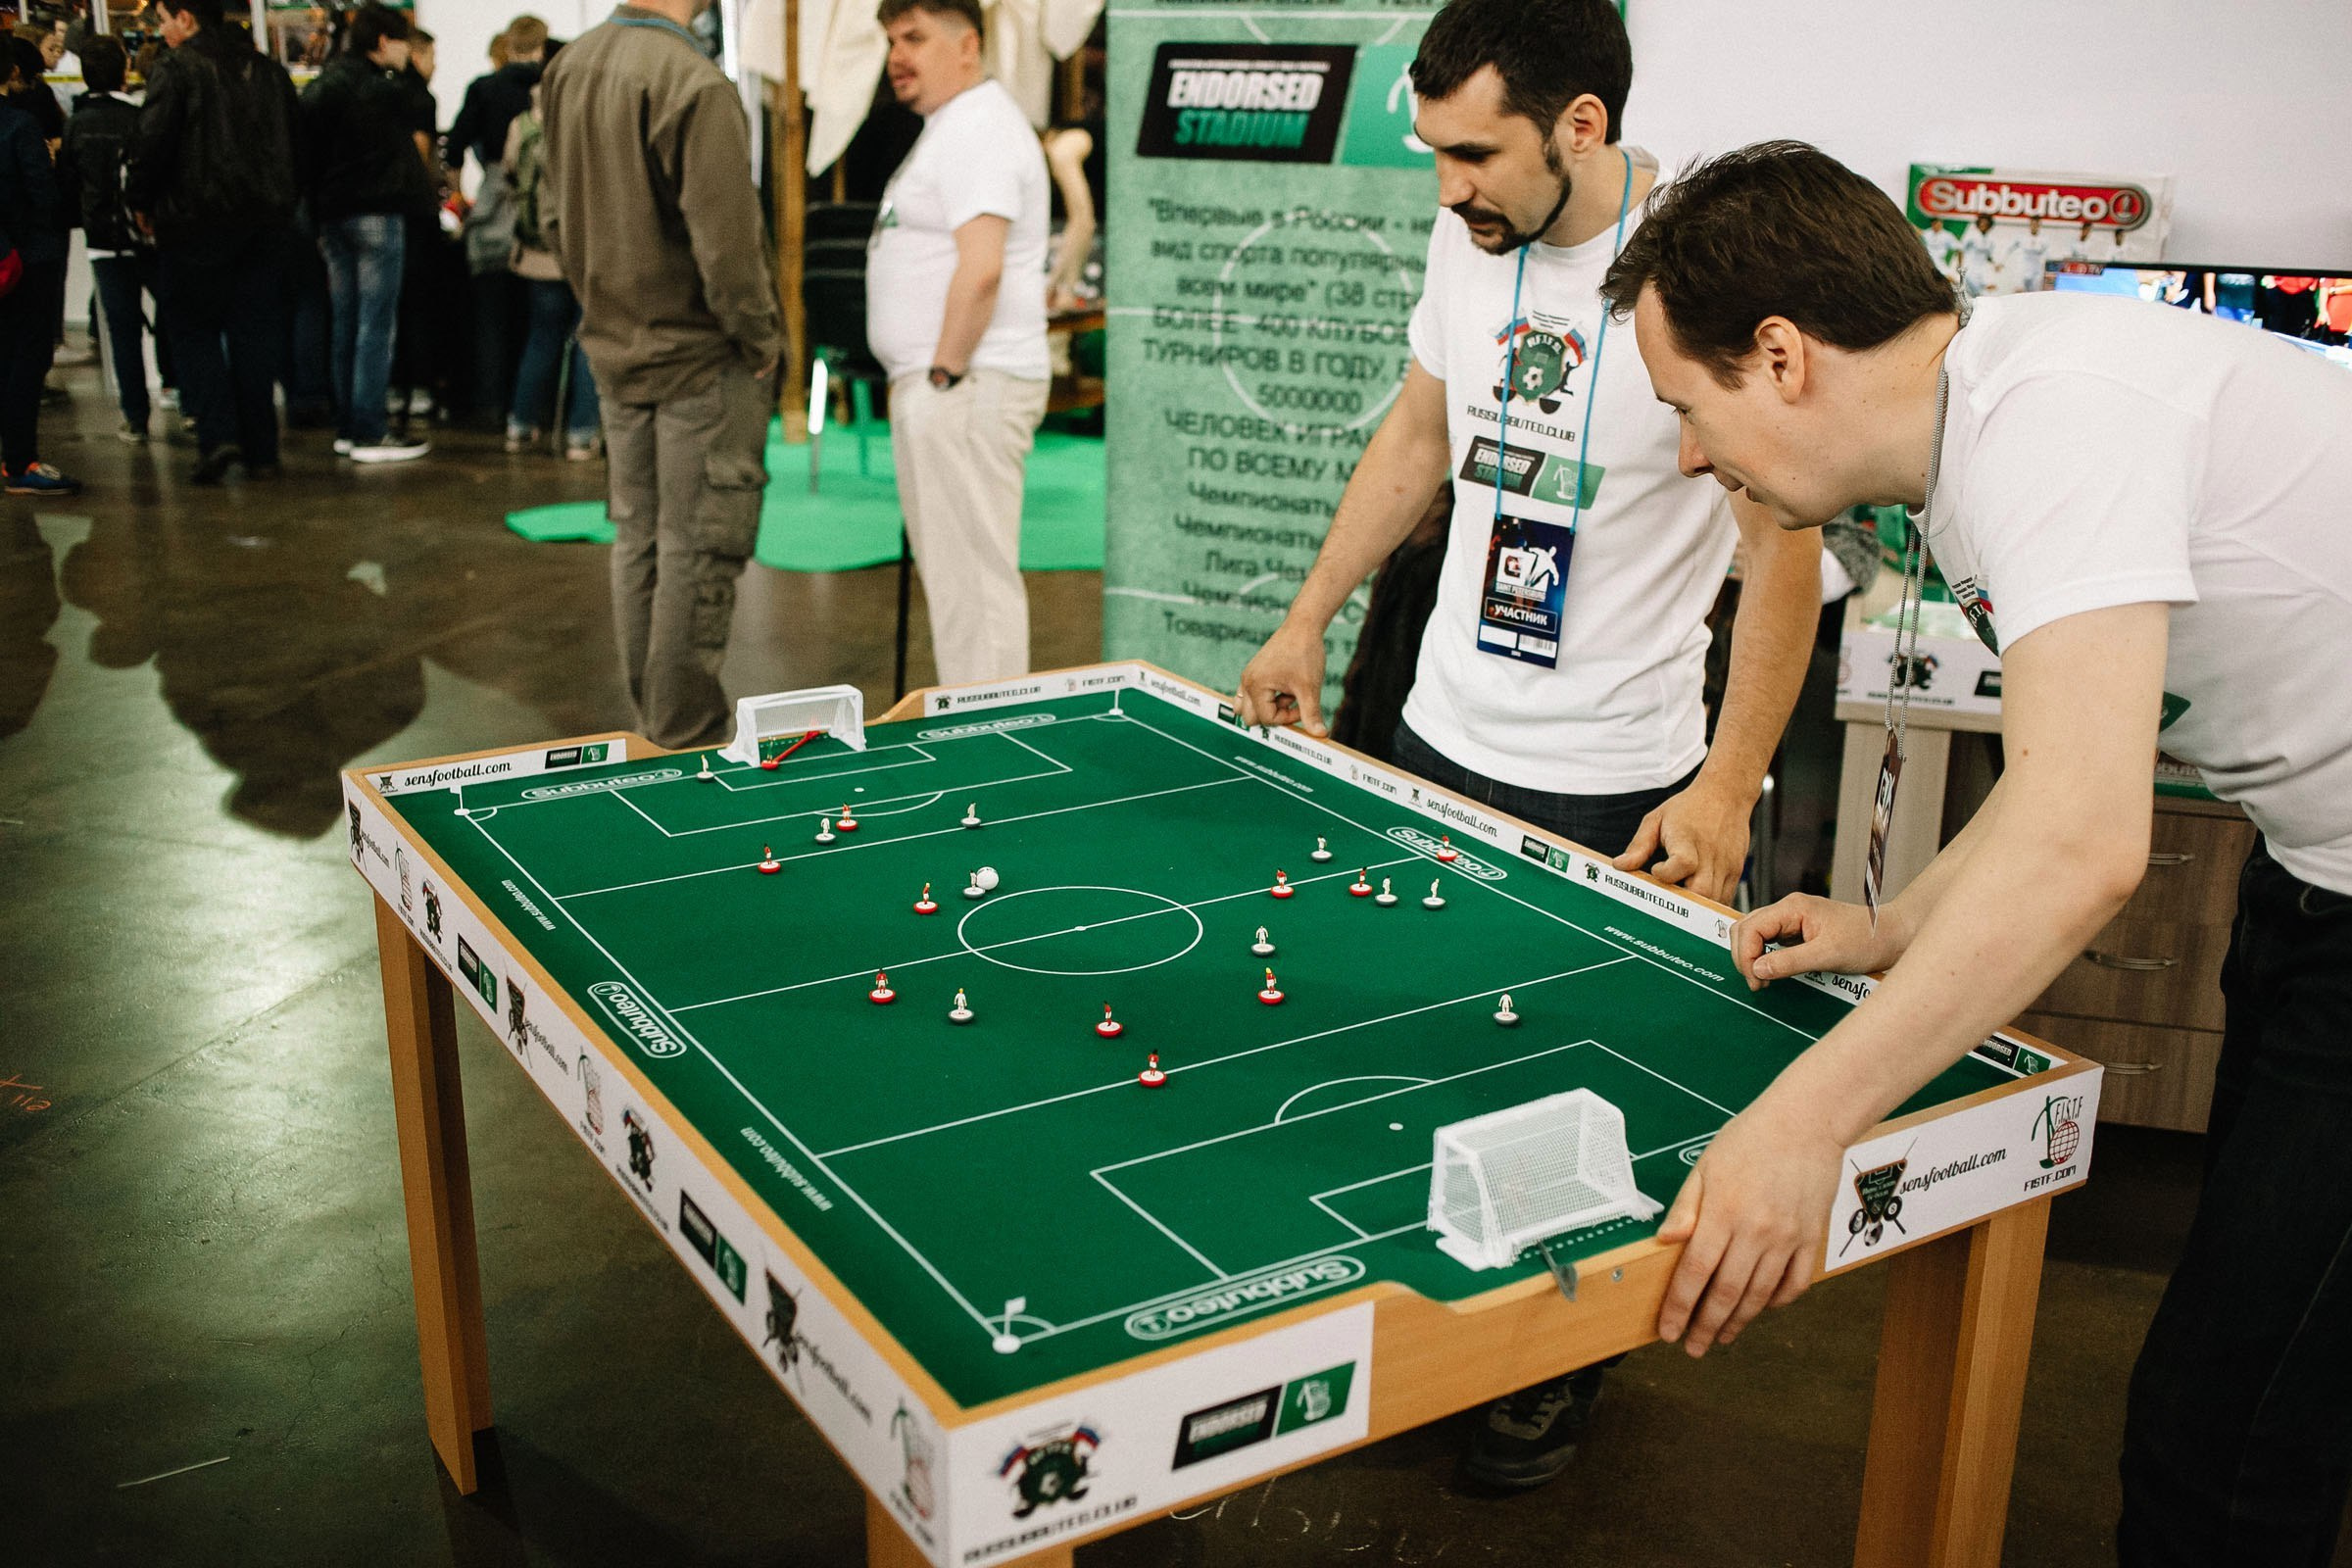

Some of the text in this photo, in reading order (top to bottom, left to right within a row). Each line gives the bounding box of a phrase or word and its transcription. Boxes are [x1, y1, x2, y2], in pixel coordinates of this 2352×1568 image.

[1167, 70, 1325, 112] ENDORSED
[1174, 110, 1310, 149] STADIUM
[1931, 177, 2108, 222] Subbuteo
[1291, 206, 1387, 233] России
[1151, 240, 1193, 261] вид
[1199, 242, 1284, 267] спорта
[1176, 278, 1236, 298] всем
[1372, 288, 1416, 313] стр
[1152, 304, 1240, 334] БОЛЕЕ
[1253, 313, 1301, 338] 400
[1142, 337, 1280, 372] ТУРНИРОВ
[1288, 349, 1305, 373] В
[1256, 382, 1363, 414] 5000000
[1164, 407, 1371, 450] ЧЕЛОВЕК ИГРА
[1188, 447, 1228, 471] ПО
[1235, 451, 1328, 481] ВСЕМУ
[1494, 604, 1548, 626] УЧАСТНИК
[403, 760, 513, 788] sensfootball.com
[530, 772, 656, 799] Subbuteo
[1426, 797, 1498, 838] sensfootball.com
[500, 878, 557, 931] www.subbuteo.com
[1603, 924, 1726, 983] www.subbuteo.com
[1831, 974, 1871, 1001] sensfo
[608, 991, 676, 1054] Subbuteo
[1899, 1147, 2008, 1195] sensfootball.com
[2023, 1164, 2078, 1193] FISTF.COM
[1165, 1259, 1352, 1323] Subbuteo
